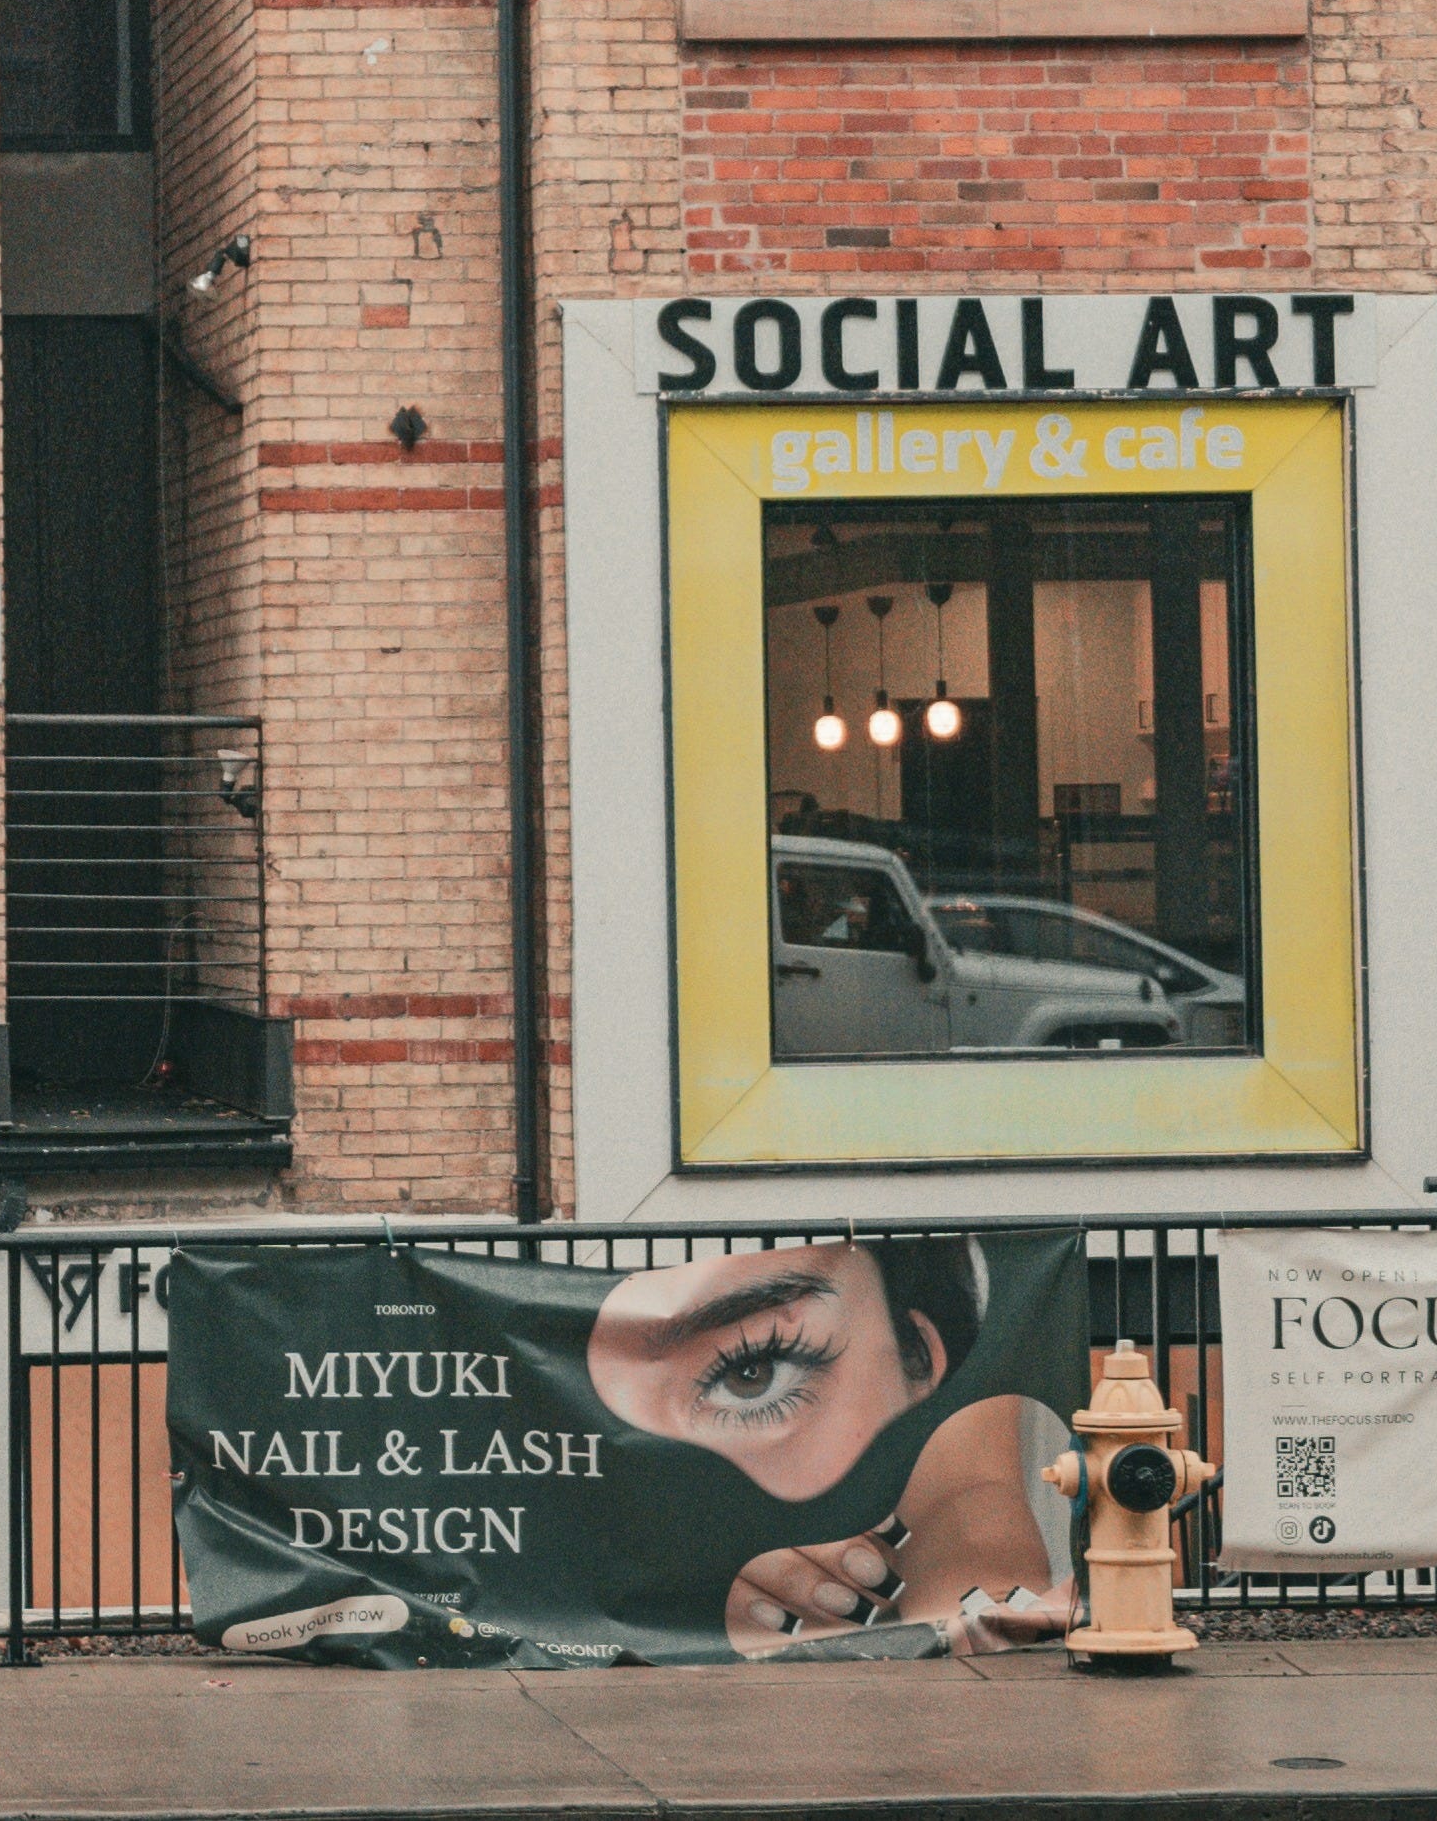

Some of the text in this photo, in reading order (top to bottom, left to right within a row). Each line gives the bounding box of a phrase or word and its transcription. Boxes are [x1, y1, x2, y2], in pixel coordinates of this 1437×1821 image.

[656, 294, 1356, 391] SOCIAL ART
[770, 407, 1245, 491] gallery & cafe
[1268, 1268, 1323, 1282] NOW
[373, 1303, 437, 1317] TORONTO
[285, 1351, 512, 1400] MIYUKI
[1270, 1372, 1326, 1385] SELF
[211, 1429, 606, 1479] NAIL & LASH
[289, 1506, 527, 1556] DESIGN
[245, 1608, 385, 1645] book yours now
